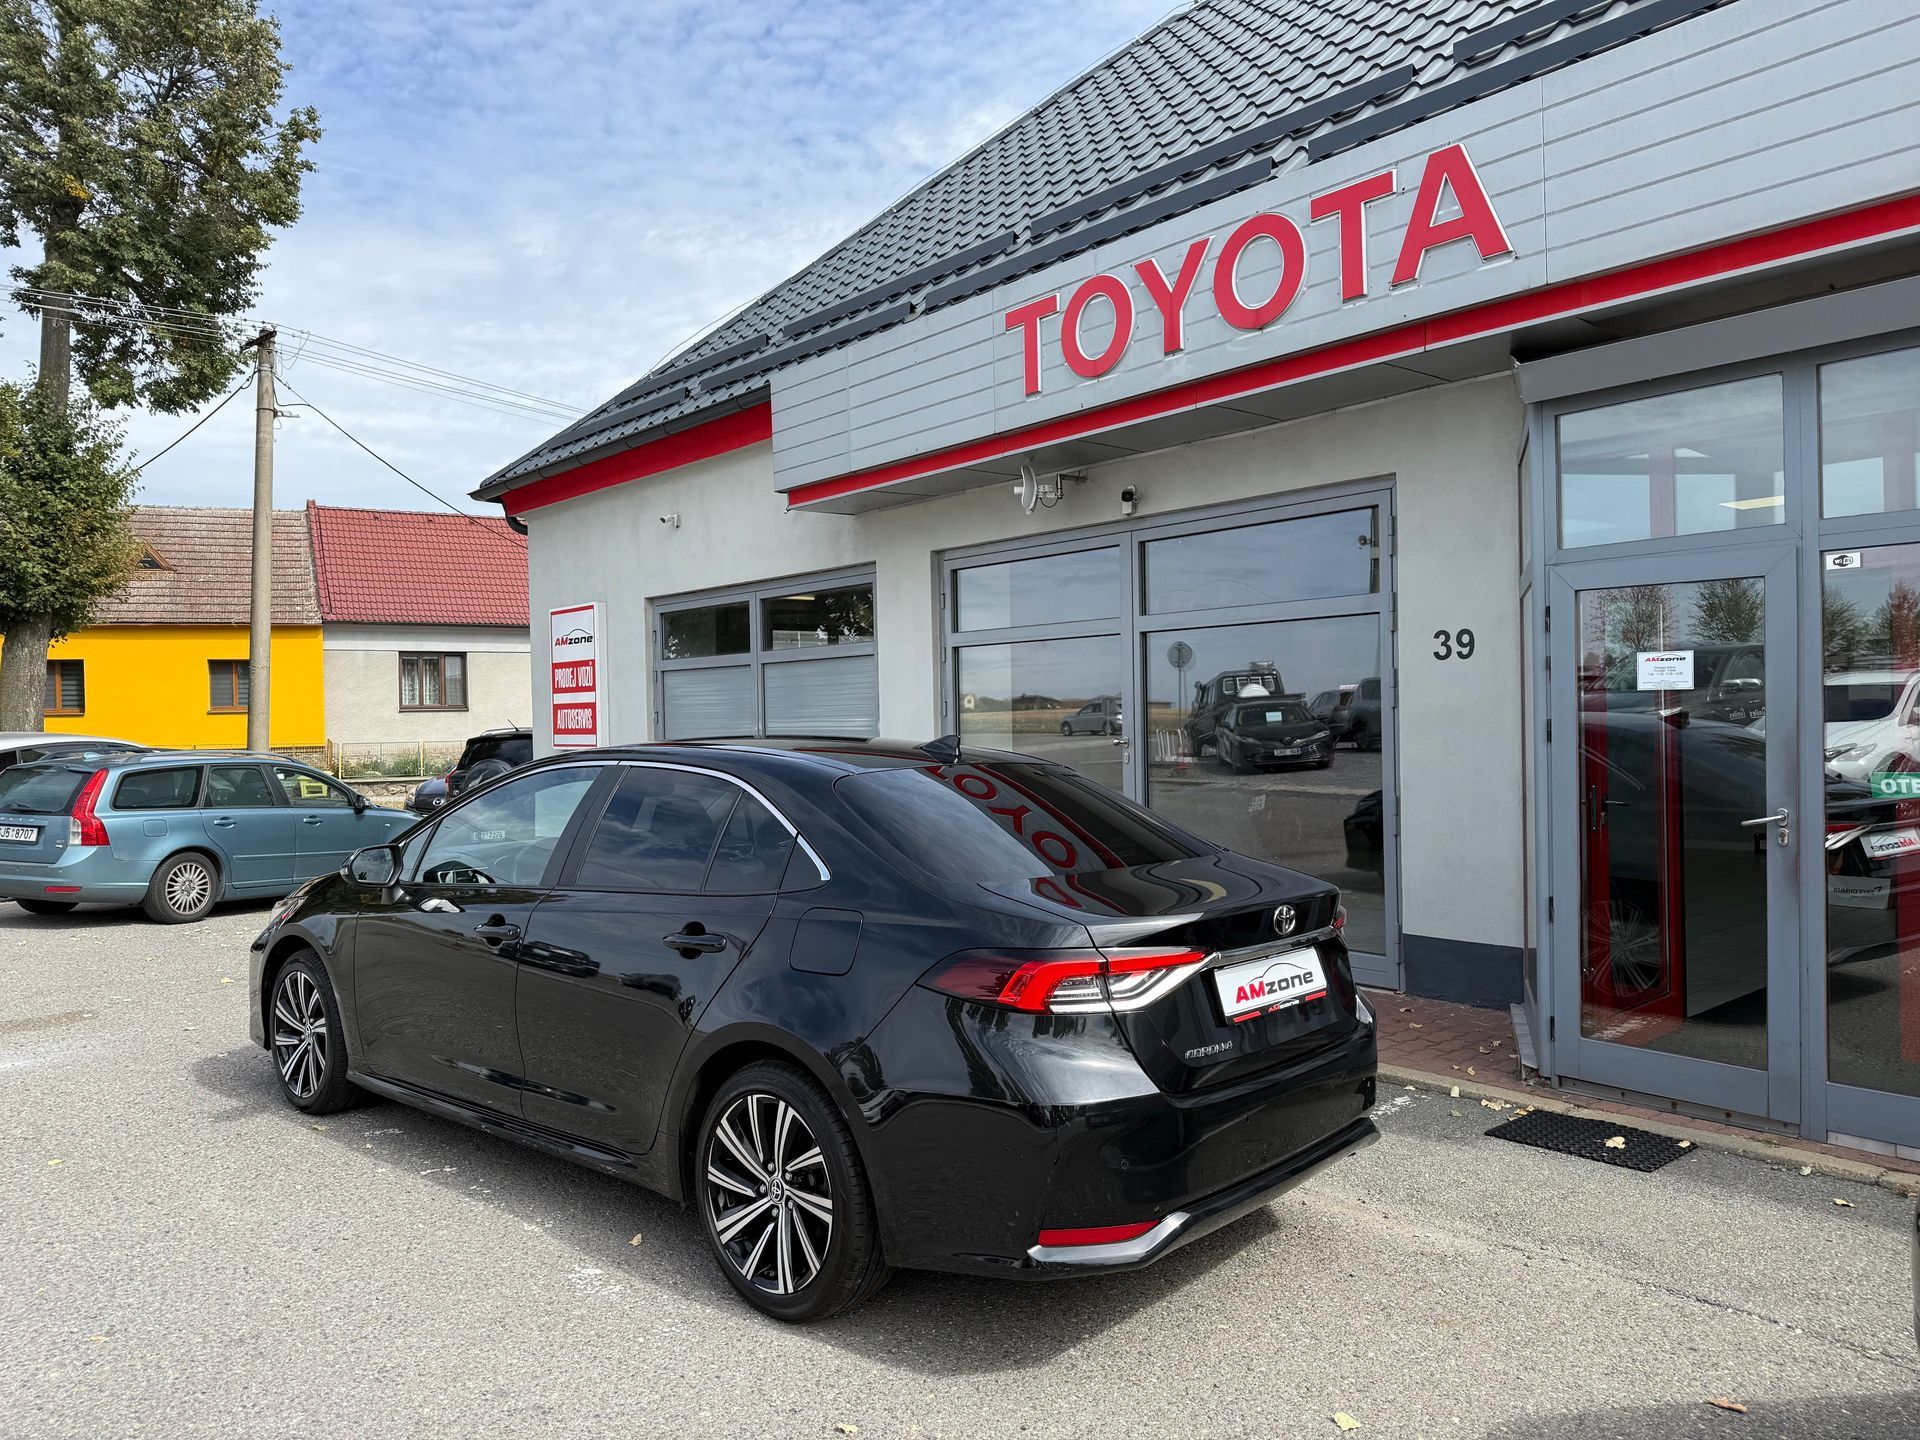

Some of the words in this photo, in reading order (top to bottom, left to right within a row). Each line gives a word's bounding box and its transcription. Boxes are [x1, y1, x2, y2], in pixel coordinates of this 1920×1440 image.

[1005, 143, 1516, 396] TOYOTA
[555, 635, 593, 646] AMzone
[1433, 628, 1475, 660] 39
[555, 667, 577, 688] PRODEJ
[557, 708, 593, 729] AUTOSERVIS
[0, 828, 11, 838] J5
[15, 828, 34, 839] 8707
[1235, 971, 1314, 1004] AMzone
